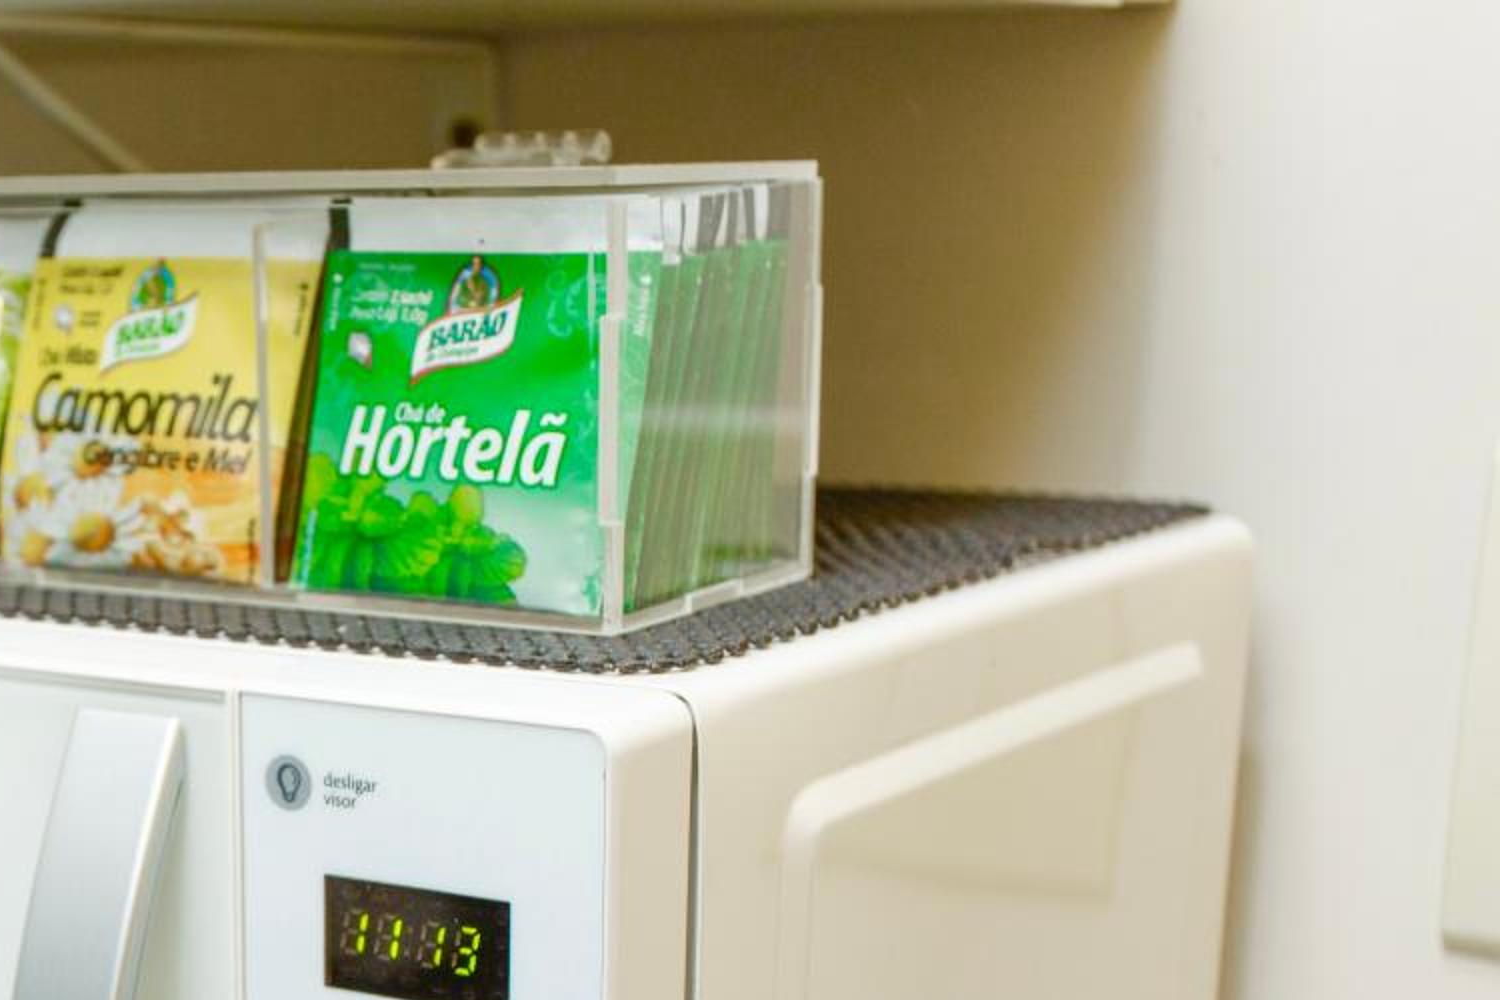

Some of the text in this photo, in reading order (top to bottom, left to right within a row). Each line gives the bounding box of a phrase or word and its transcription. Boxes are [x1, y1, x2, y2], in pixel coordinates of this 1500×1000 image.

[32, 371, 258, 442] Camomila
[395, 402, 446, 424] Chá de
[83, 440, 252, 475] Gengibre e Mel
[340, 405, 568, 487] Hortelã
[323, 771, 377, 795] desligar
[323, 794, 358, 809] visor
